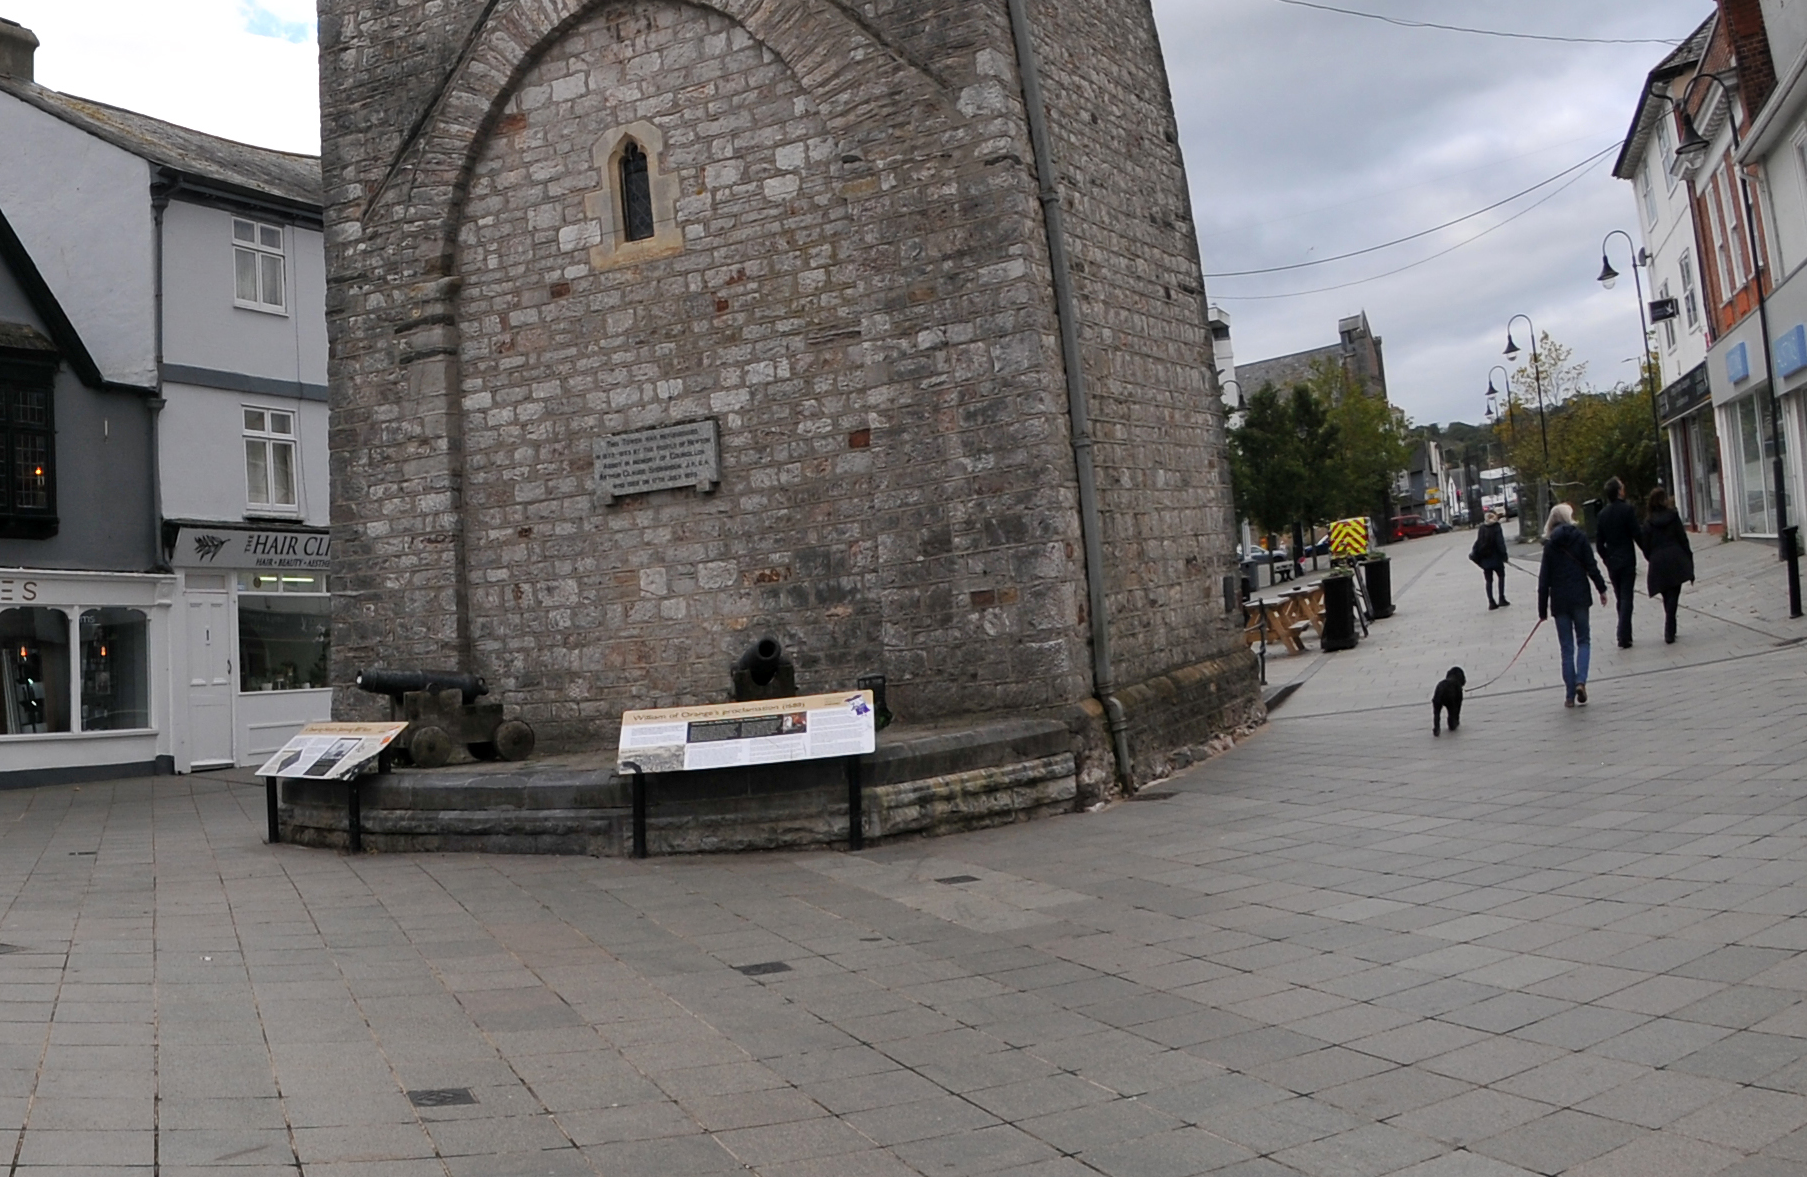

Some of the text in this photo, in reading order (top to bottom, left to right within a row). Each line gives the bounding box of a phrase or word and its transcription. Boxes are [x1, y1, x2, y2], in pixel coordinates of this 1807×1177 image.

[245, 534, 255, 553] THE
[252, 534, 299, 555] HAIR
[255, 558, 274, 567] HAIR
[277, 558, 304, 567] BEAUTY
[632, 713, 666, 722] William
[668, 711, 679, 719] of
